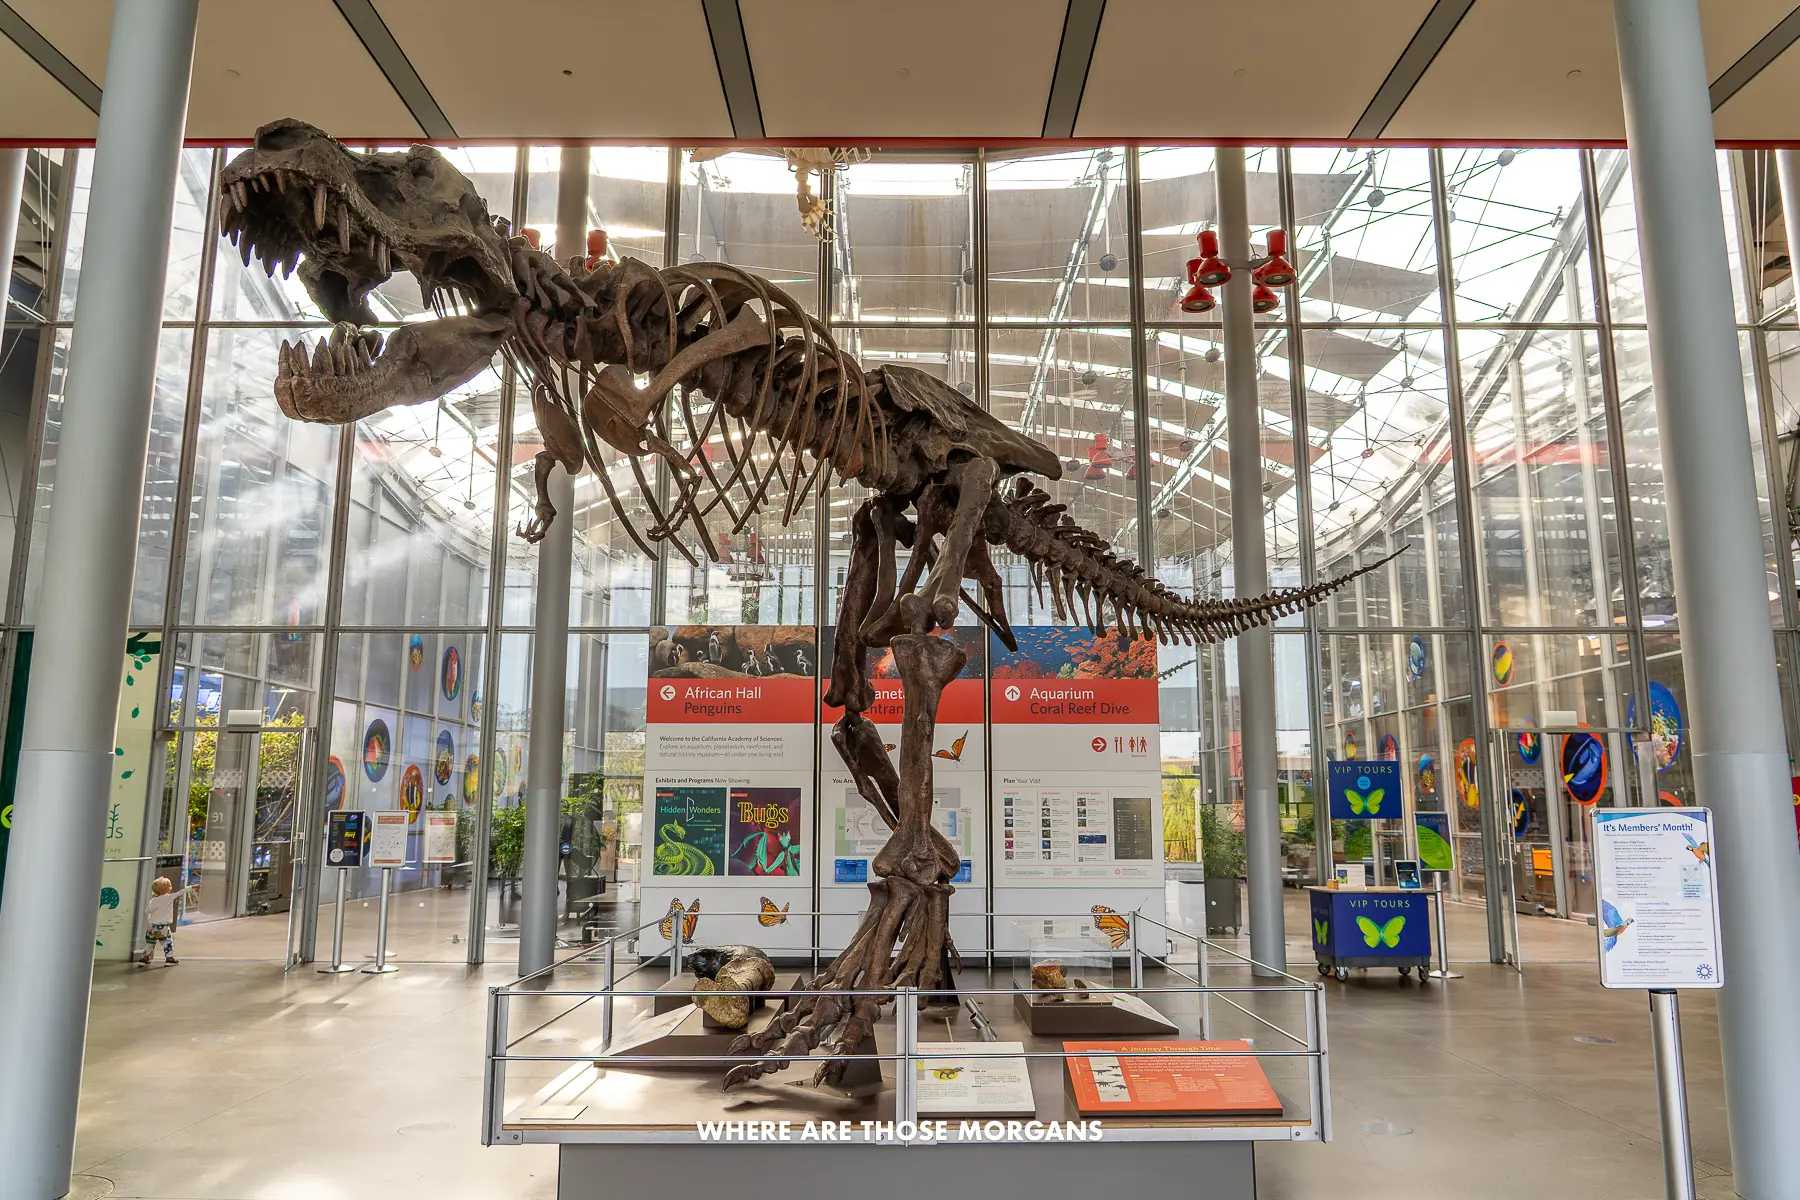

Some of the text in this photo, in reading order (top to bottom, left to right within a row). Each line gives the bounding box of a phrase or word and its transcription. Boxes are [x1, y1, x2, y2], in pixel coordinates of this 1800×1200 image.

[685, 686, 762, 699] African Hall
[1030, 687, 1095, 702] Aquarium
[684, 702, 742, 716] Penguins
[863, 704, 904, 715] ntran
[1030, 702, 1130, 715] Coral Reef Dive
[727, 736, 752, 744] Academy
[1334, 766, 1393, 774] VIP TOURS
[688, 777, 714, 785] Programs
[728, 777, 750, 785] Showing
[660, 806, 721, 814] Hidden Wonders
[737, 801, 789, 829] Bugs
[1603, 823, 1693, 832] It's Members' Month!
[1350, 900, 1411, 908] VIP TOURS
